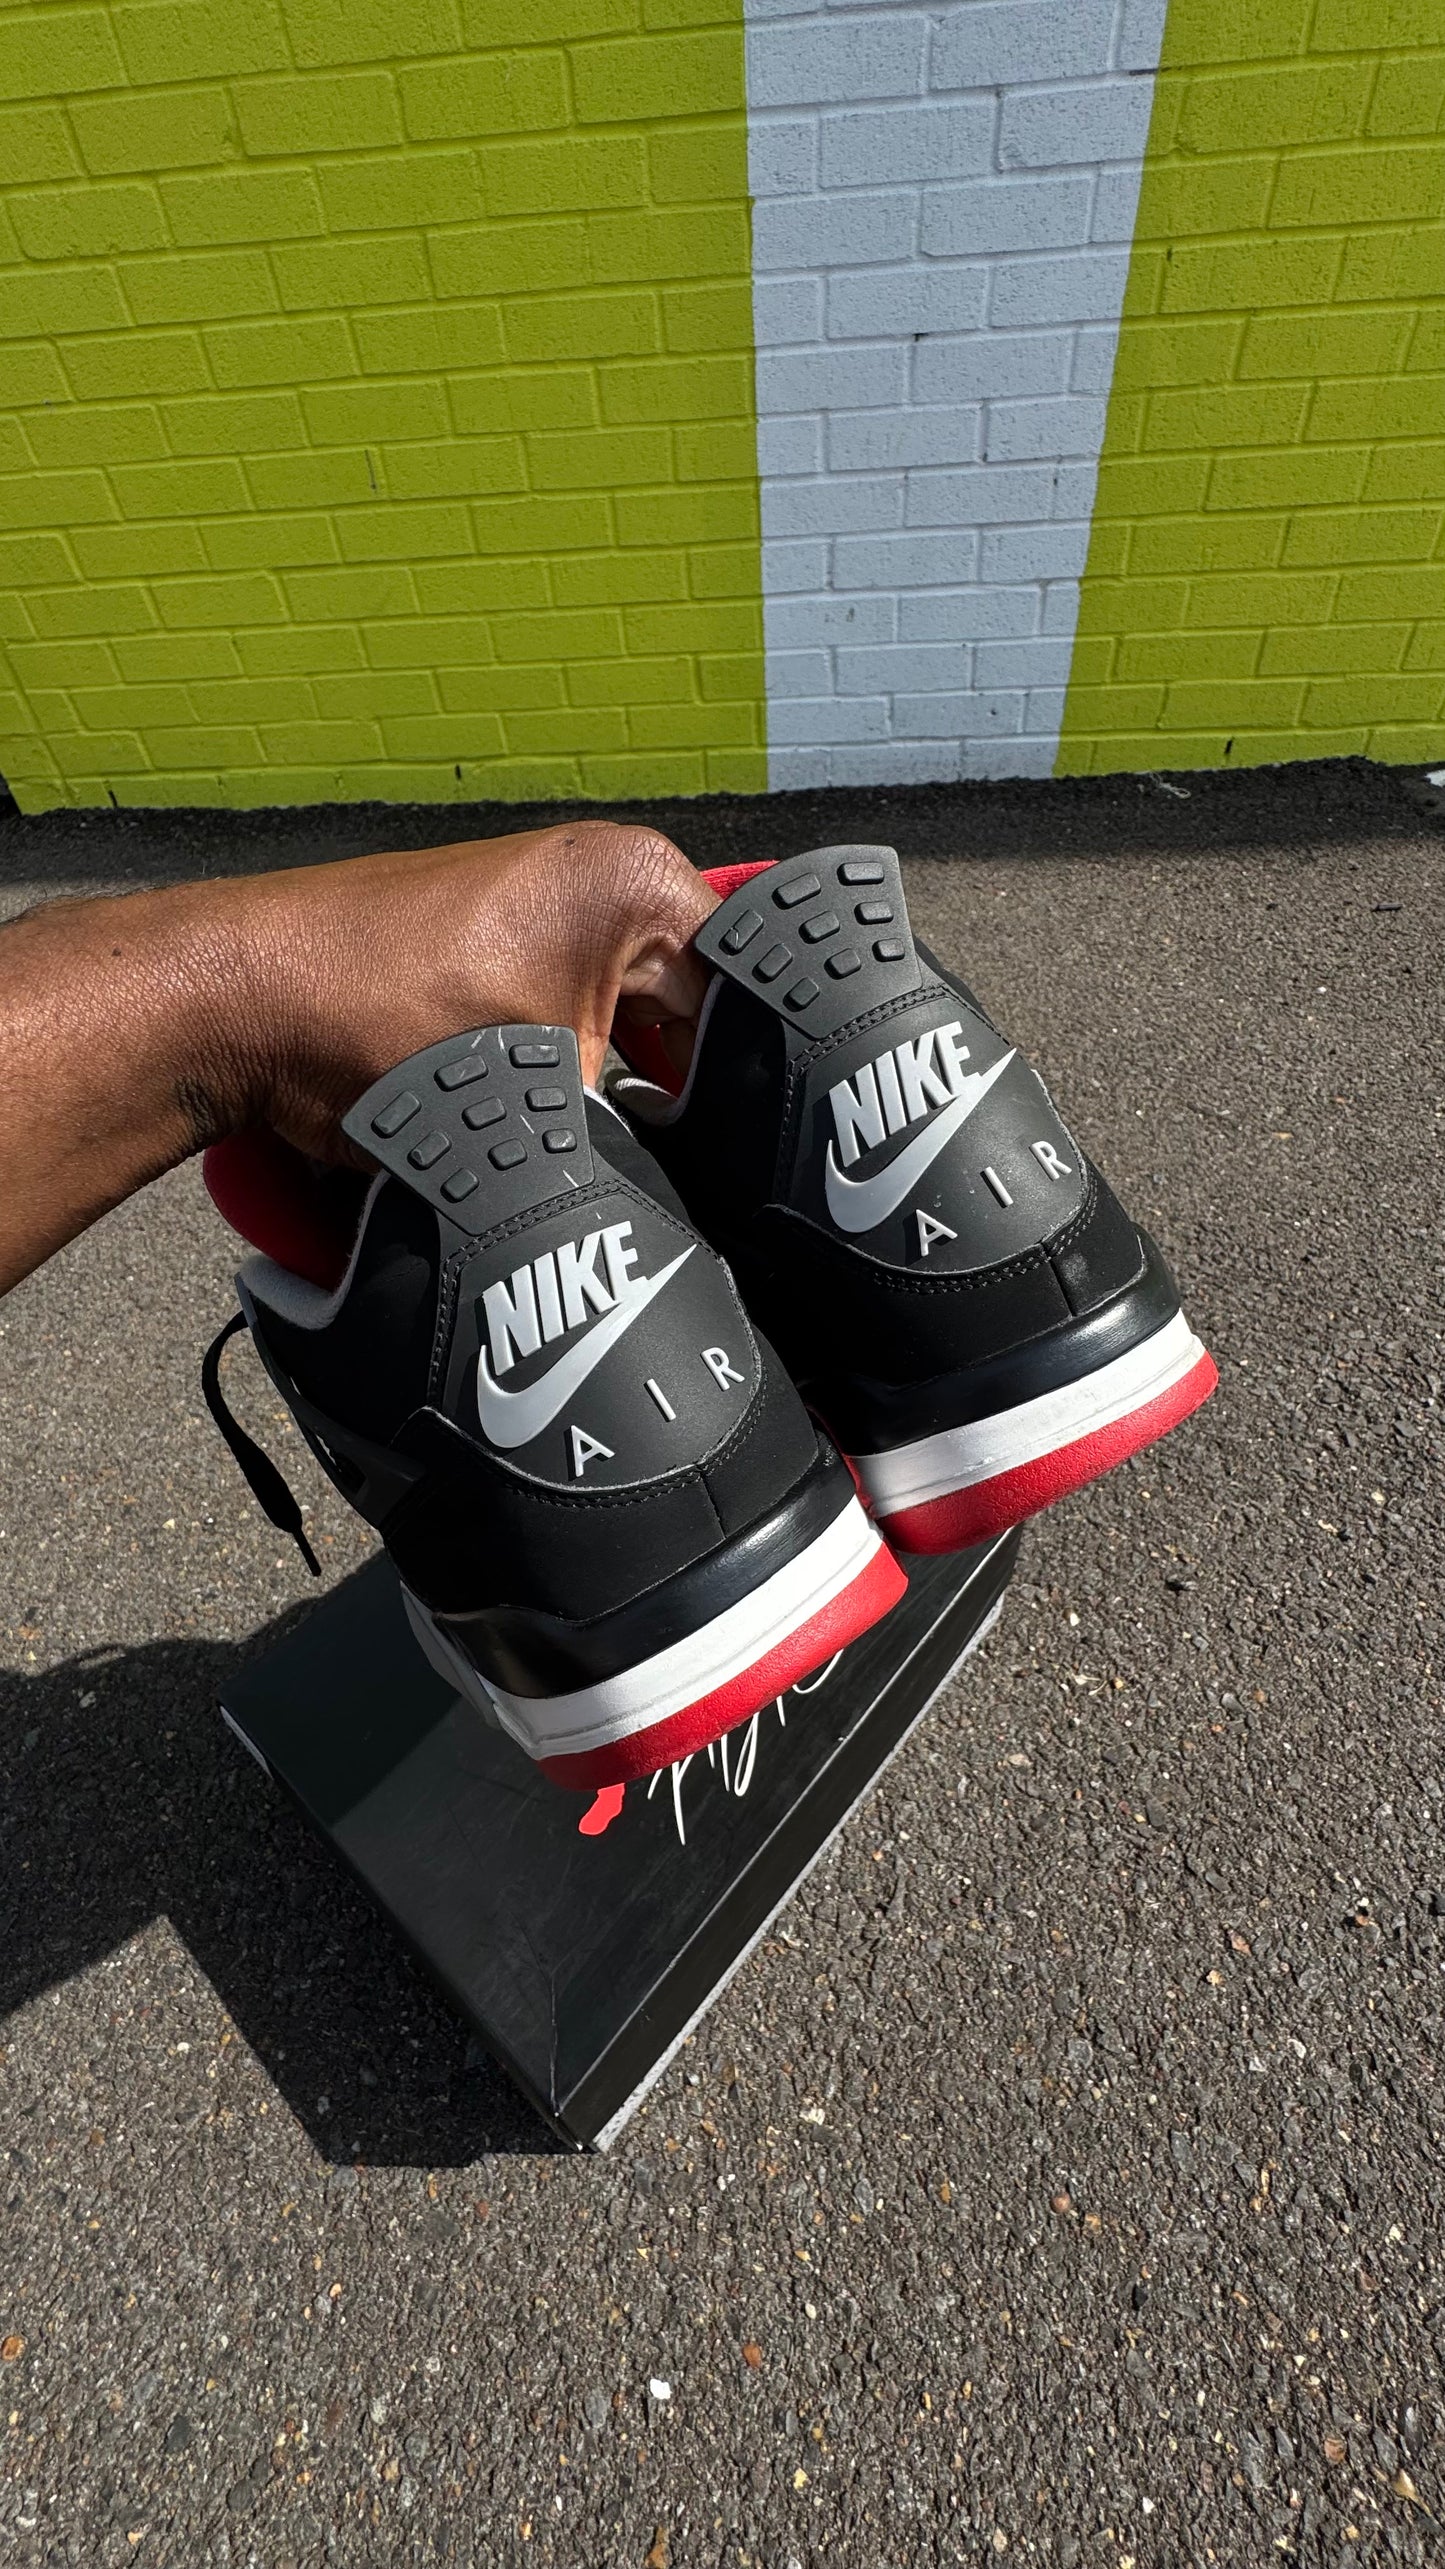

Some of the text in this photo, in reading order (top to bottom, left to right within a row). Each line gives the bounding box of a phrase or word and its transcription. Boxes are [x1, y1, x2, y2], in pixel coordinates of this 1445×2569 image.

[829, 1021, 982, 1168] NIKE
[915, 1140, 1073, 1257] AIR
[482, 1220, 650, 1376] NIKE
[570, 1346, 746, 1478] AIR
